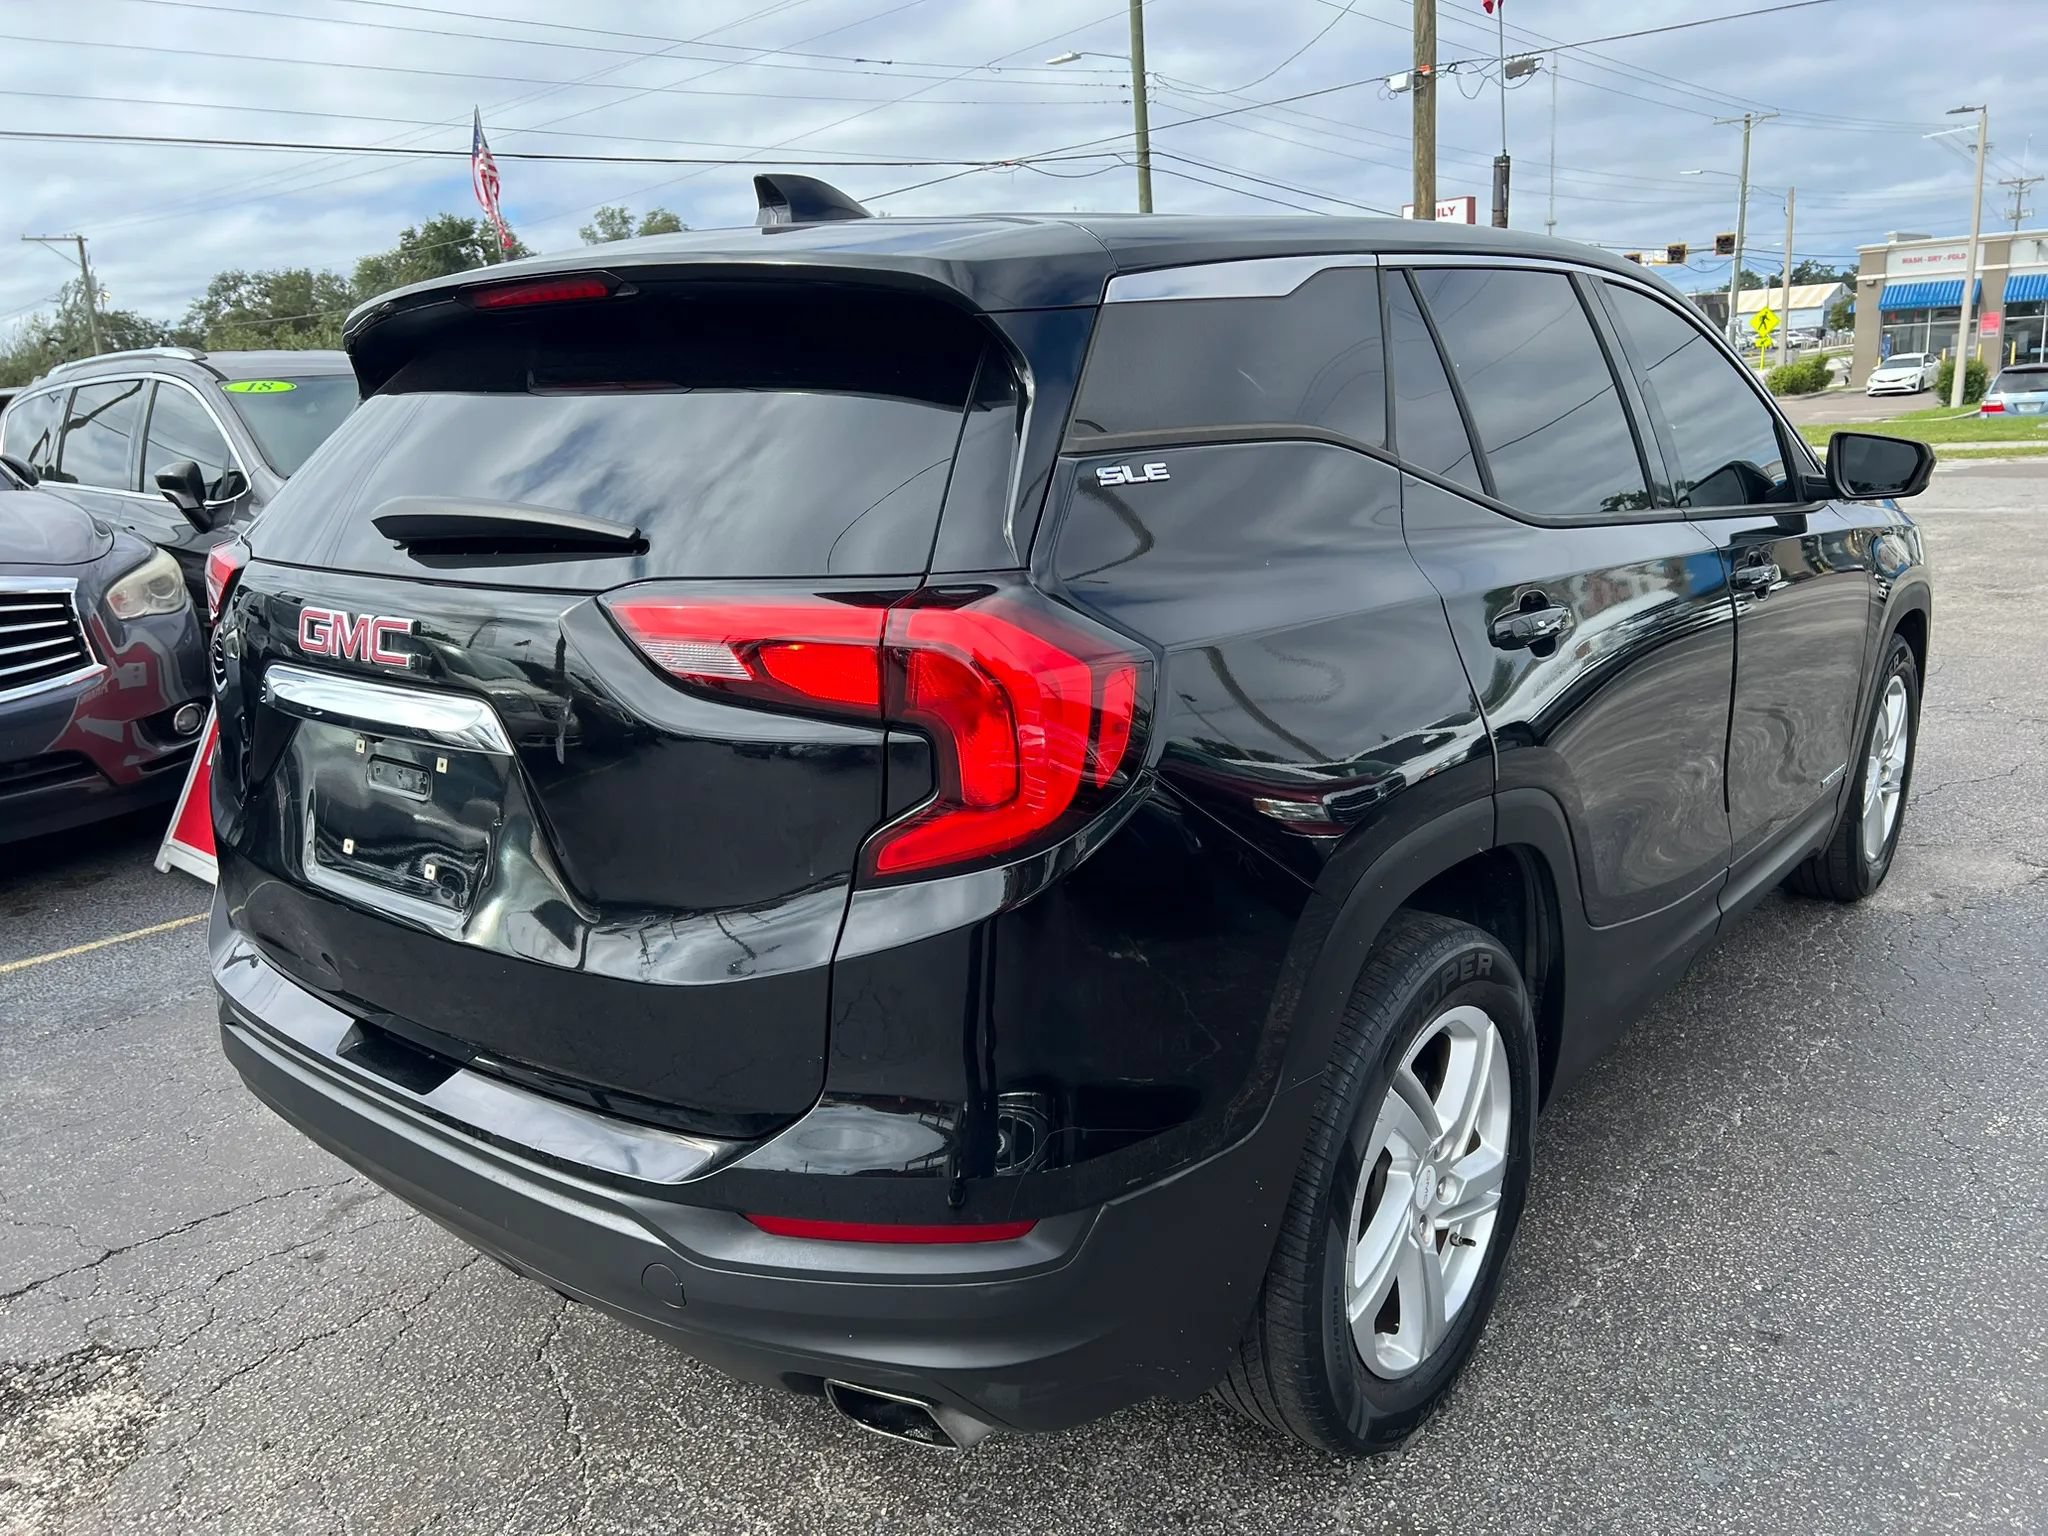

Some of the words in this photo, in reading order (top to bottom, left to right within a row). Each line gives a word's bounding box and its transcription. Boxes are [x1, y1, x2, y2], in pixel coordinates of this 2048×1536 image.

[1947, 253, 1967, 261] FOLD
[1095, 462, 1171, 487] SLE
[298, 605, 414, 670] GMC
